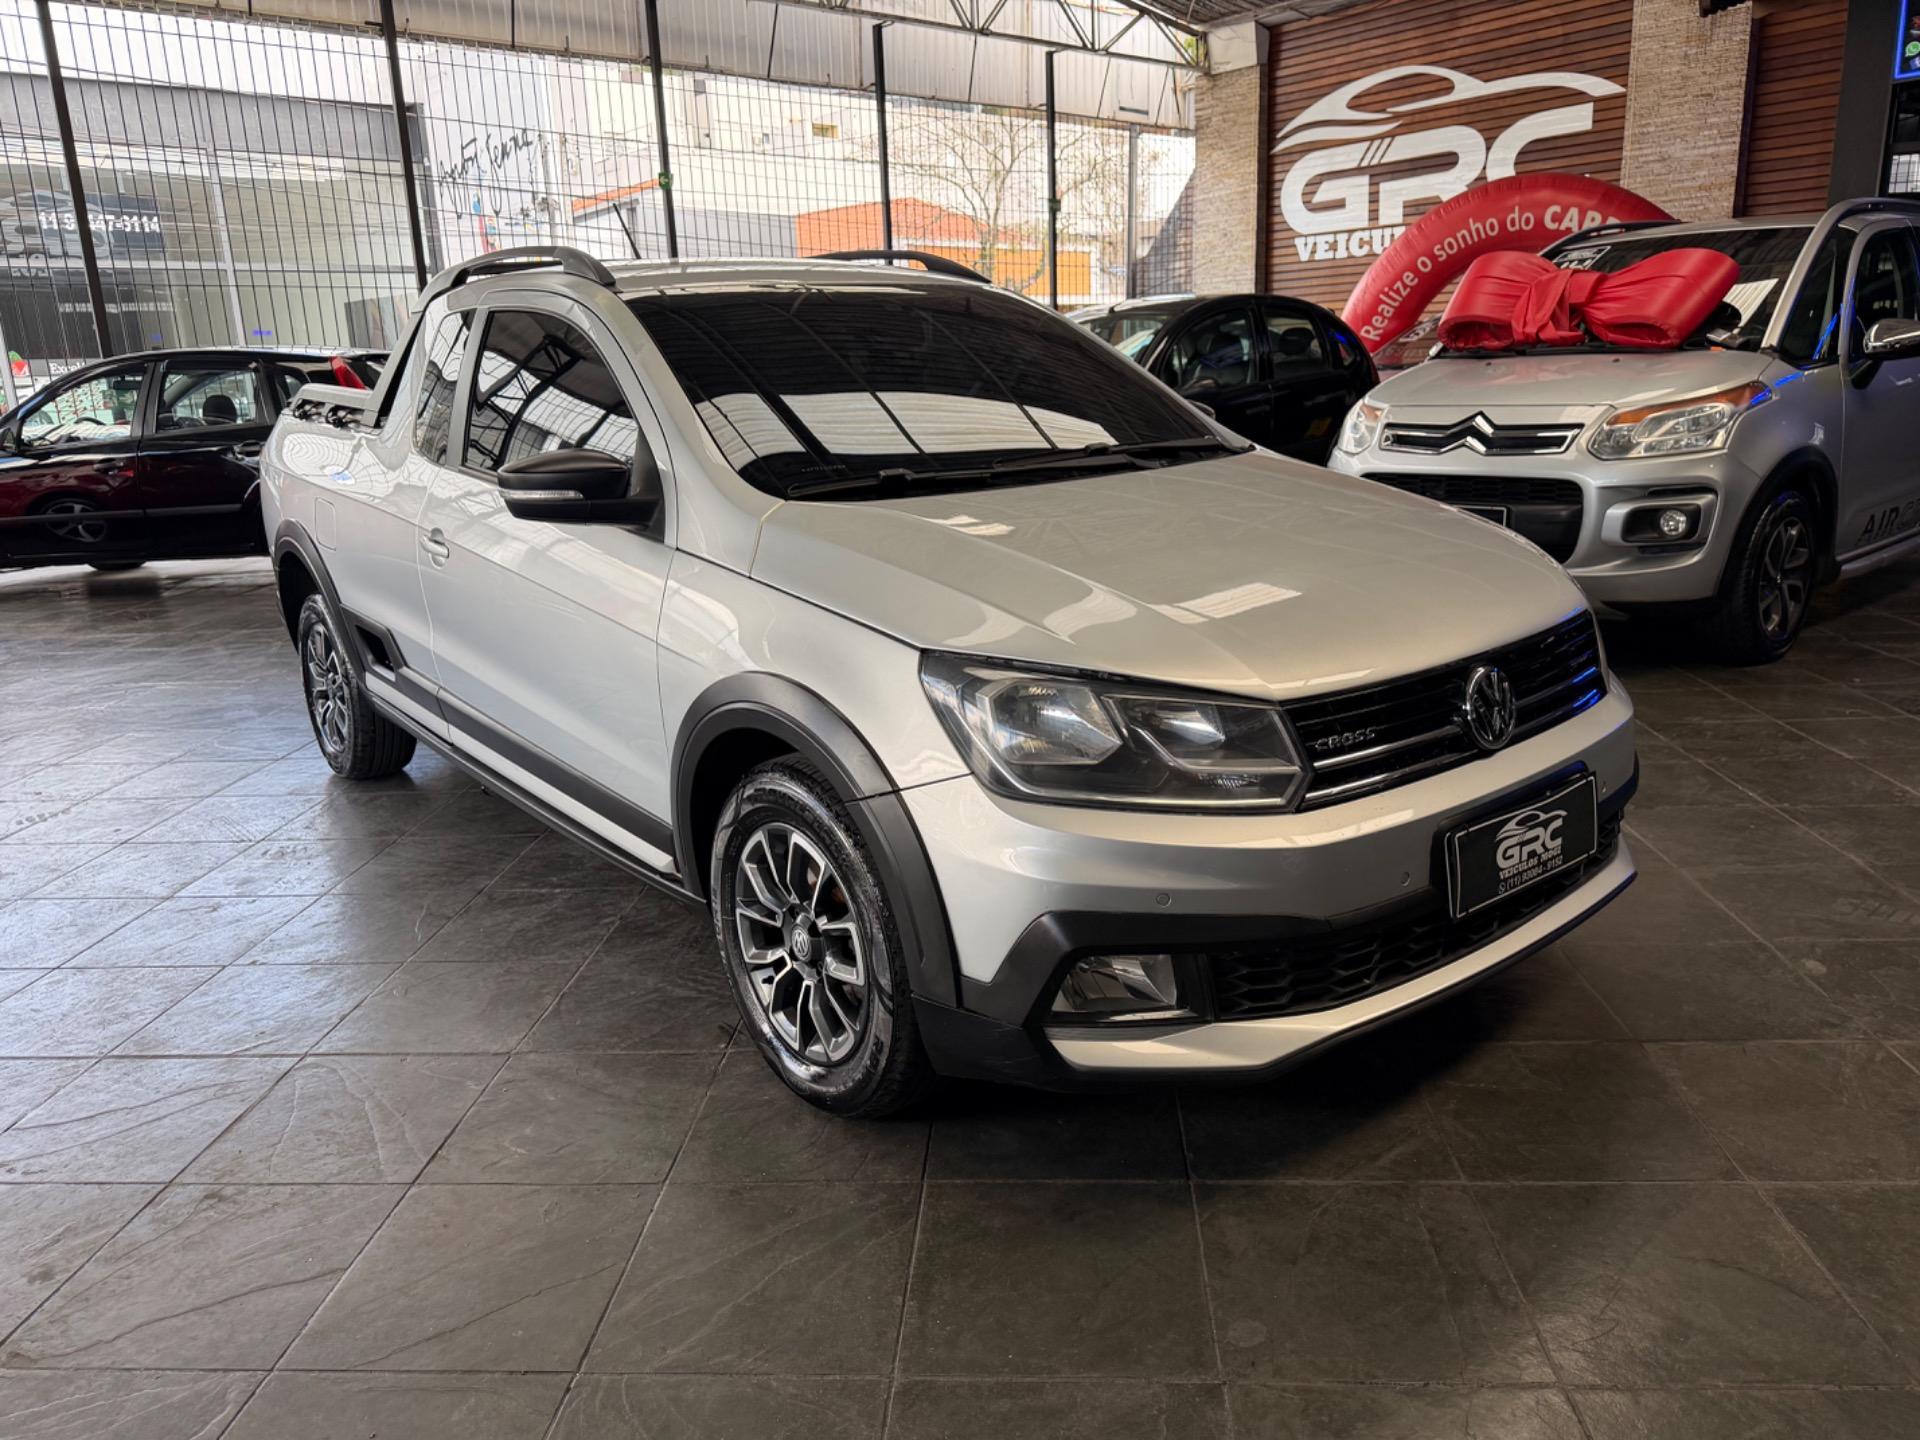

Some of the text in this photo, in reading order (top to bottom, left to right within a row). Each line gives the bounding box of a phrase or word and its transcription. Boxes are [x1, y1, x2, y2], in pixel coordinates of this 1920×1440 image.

[1280, 102, 1594, 234] GRC
[1360, 271, 1419, 342] Realize
[1417, 255, 1433, 274] o
[1433, 216, 1499, 262] sonho
[1506, 205, 1536, 232] do
[1314, 726, 1378, 751] CROSS
[1496, 817, 1563, 869] GRC
